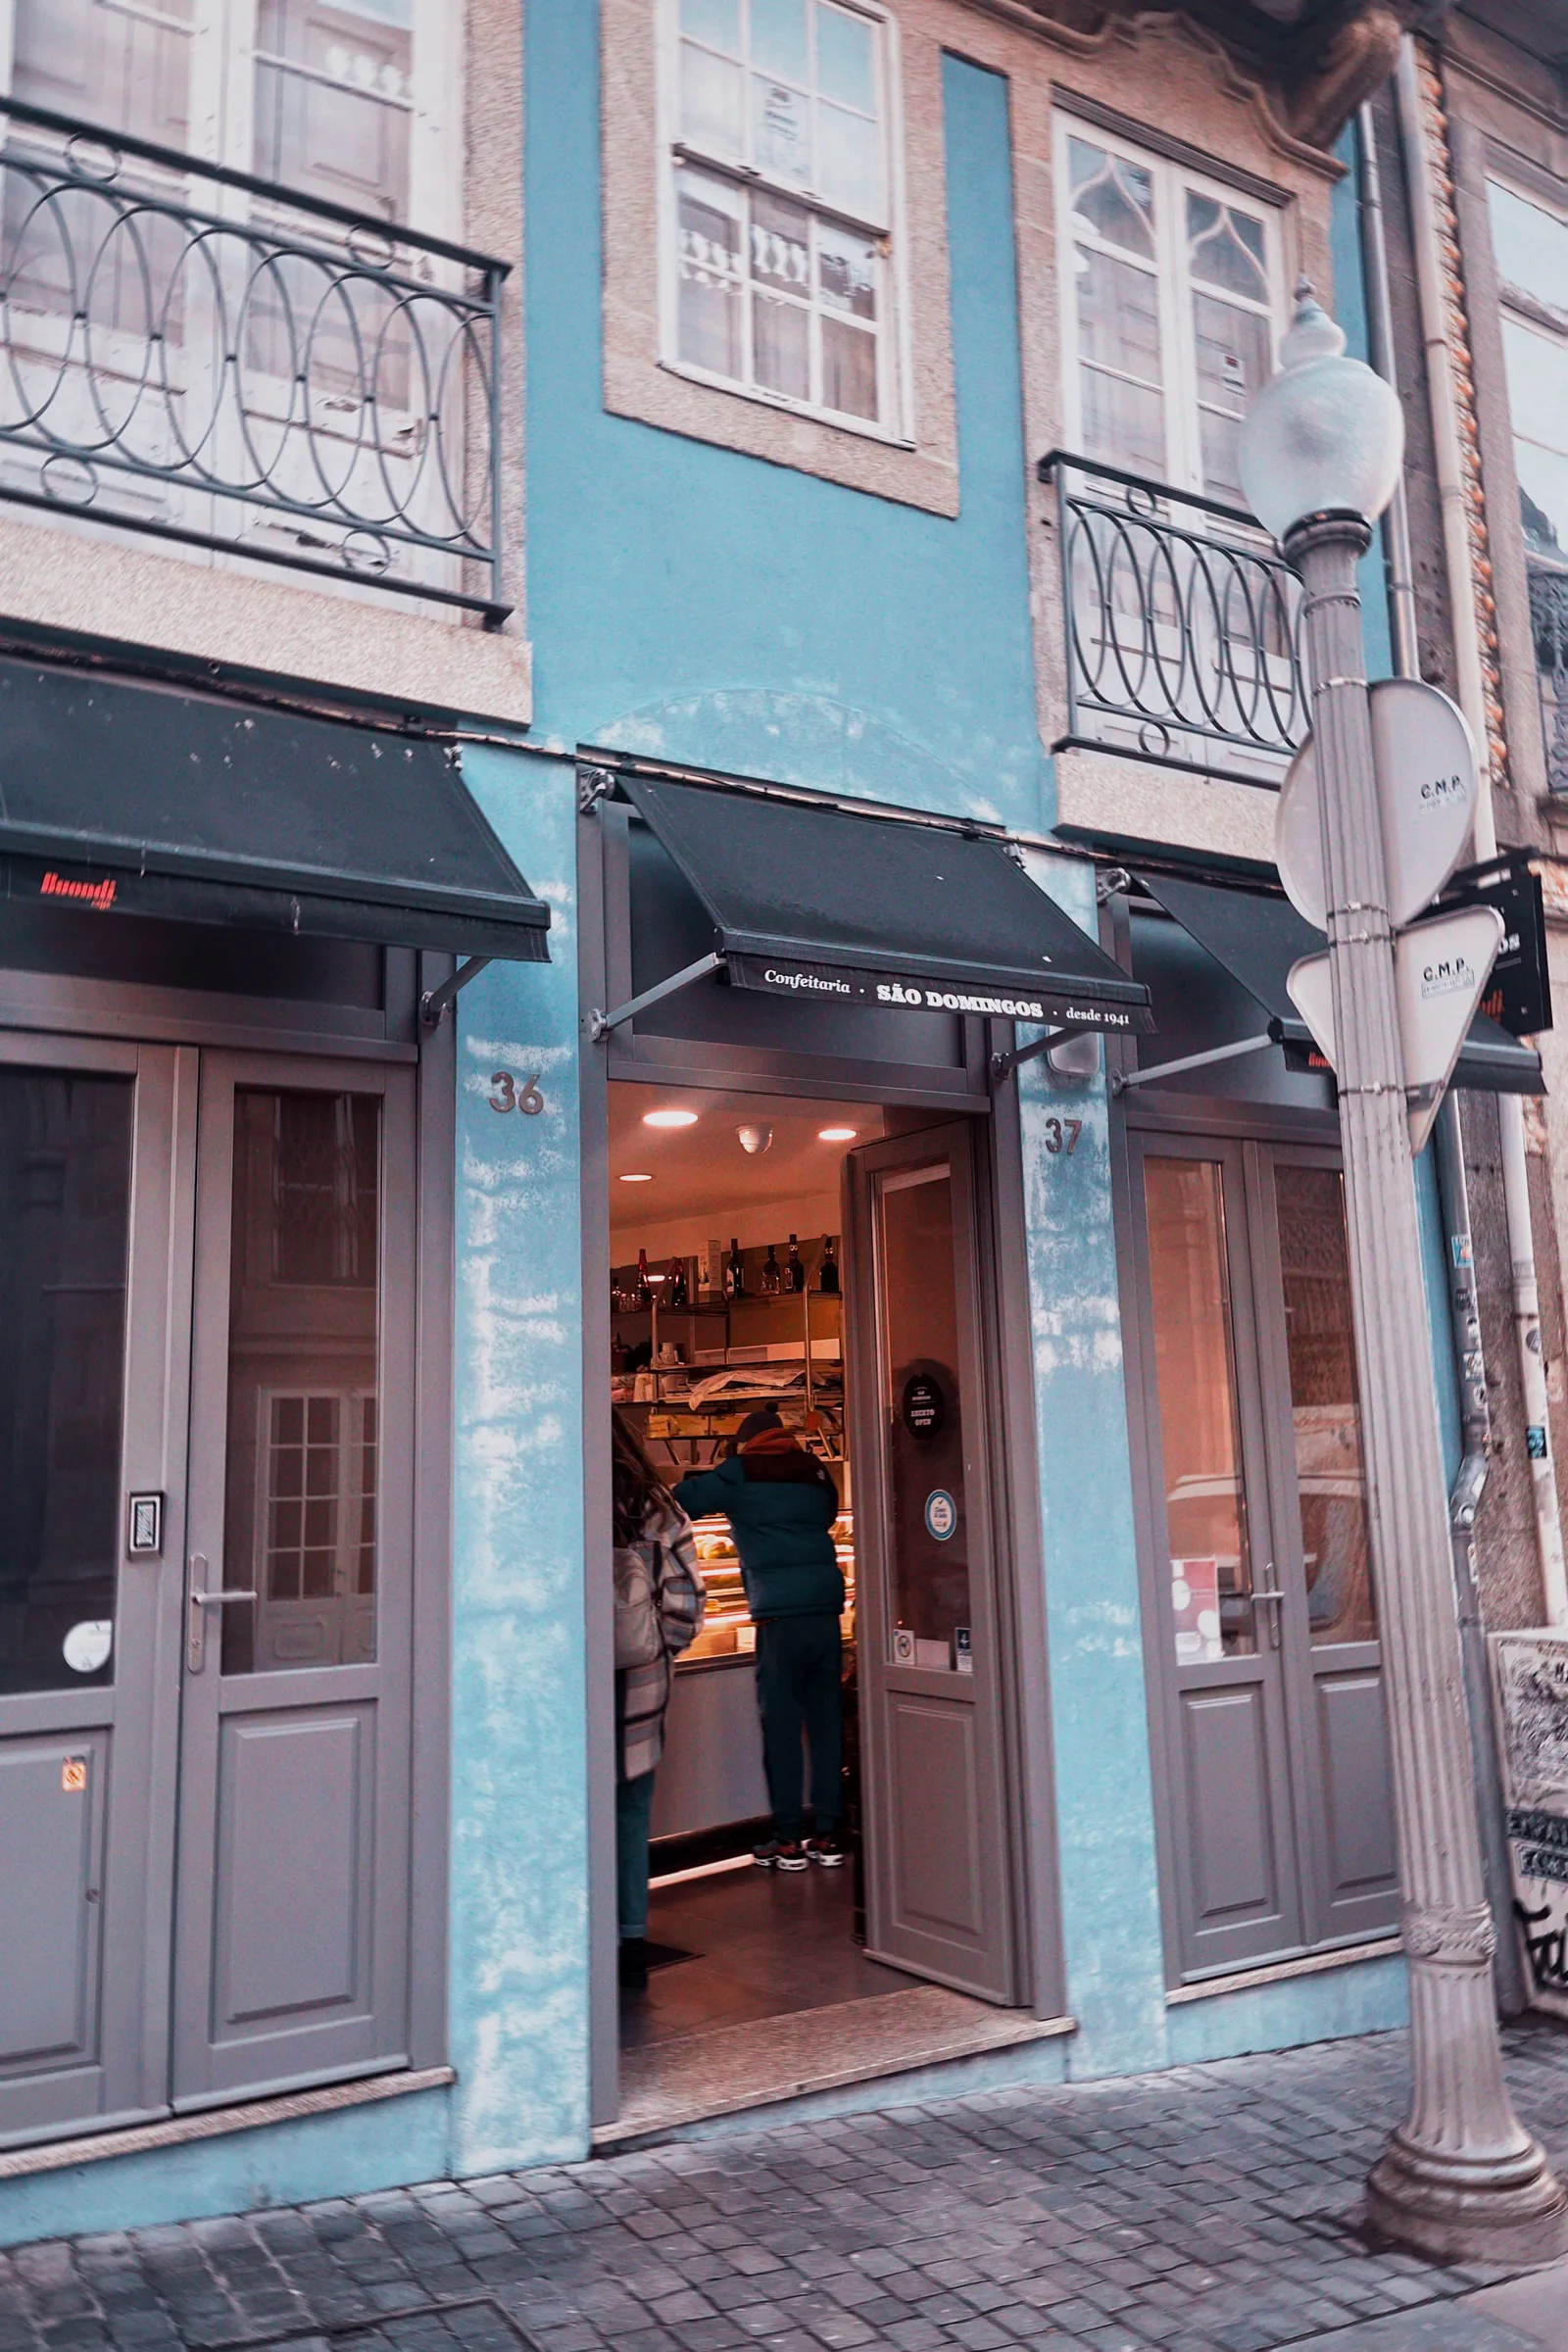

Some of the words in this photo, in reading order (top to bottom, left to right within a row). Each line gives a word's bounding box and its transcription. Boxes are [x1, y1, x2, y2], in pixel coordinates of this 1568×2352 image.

[1423, 957, 1469, 982] C.M.P.
[764, 969, 851, 994] Confeitaria
[876, 983, 922, 1004] SÃO
[925, 991, 1044, 1017] DOMINGOS
[1065, 1006, 1102, 1022] desde
[1103, 1012, 1130, 1026] 1941
[489, 1071, 544, 1114] 36
[1046, 1117, 1082, 1155] 37
